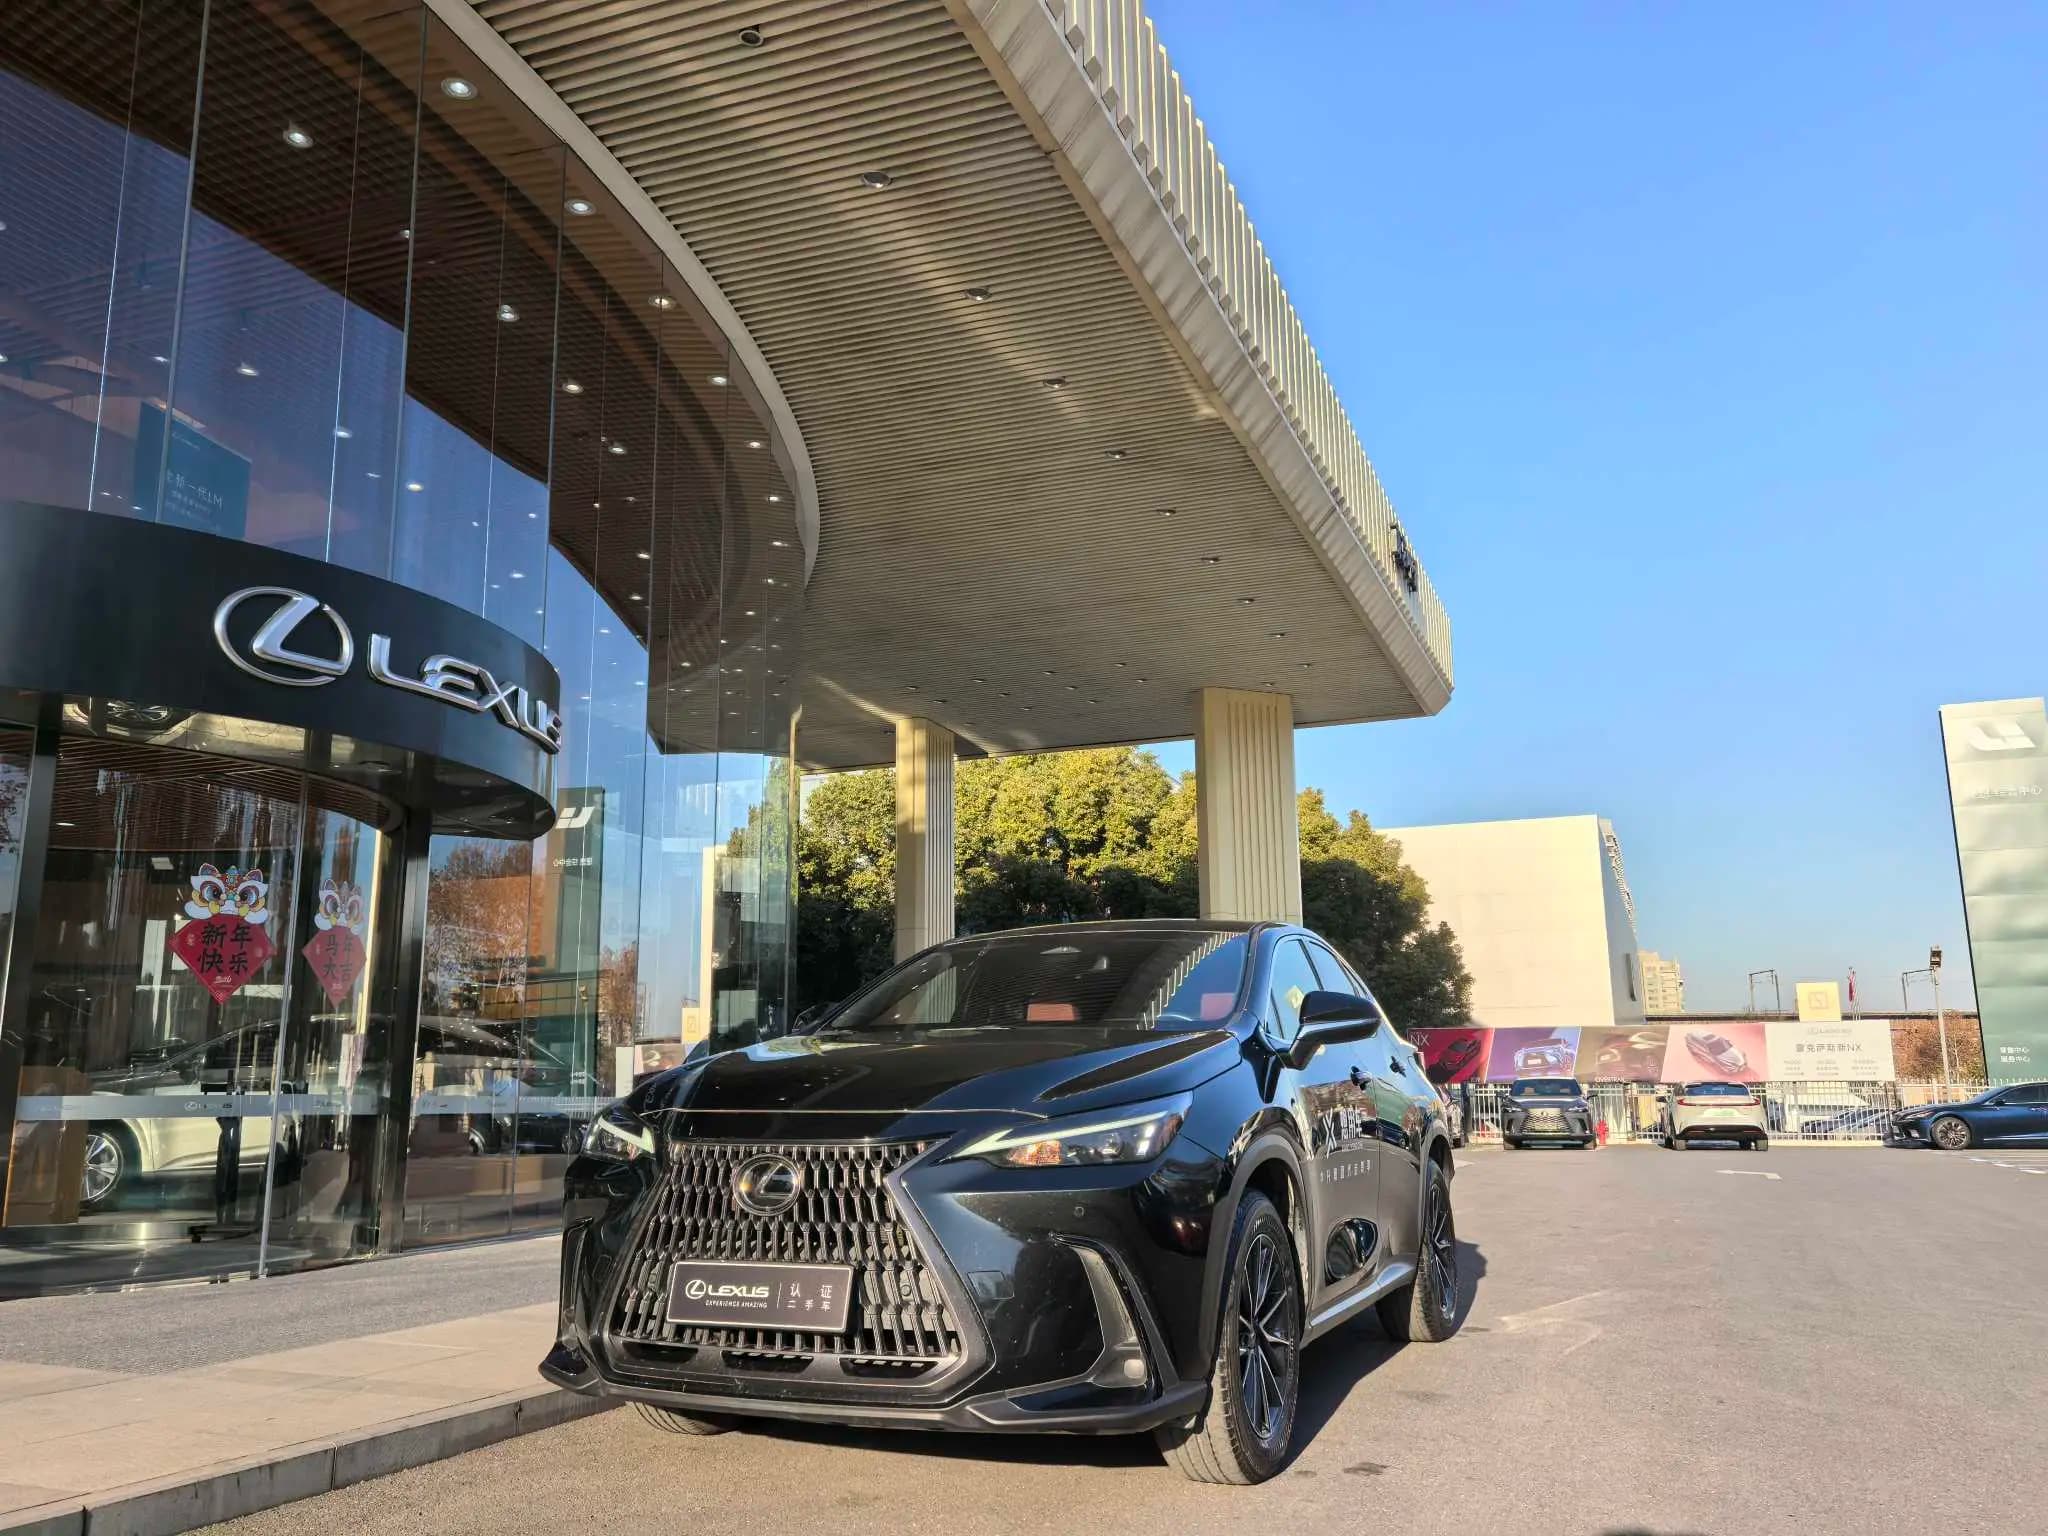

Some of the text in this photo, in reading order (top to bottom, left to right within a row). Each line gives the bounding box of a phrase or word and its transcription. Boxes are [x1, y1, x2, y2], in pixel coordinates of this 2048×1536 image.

[201, 923, 252, 949] 新年
[198, 949, 249, 975] 快乐
[708, 1284, 769, 1298] LEXUS
[790, 1282, 832, 1299] 认证
[705, 1300, 768, 1309] EXPERIENCE AMAZING
[787, 1299, 831, 1312] 二手车
